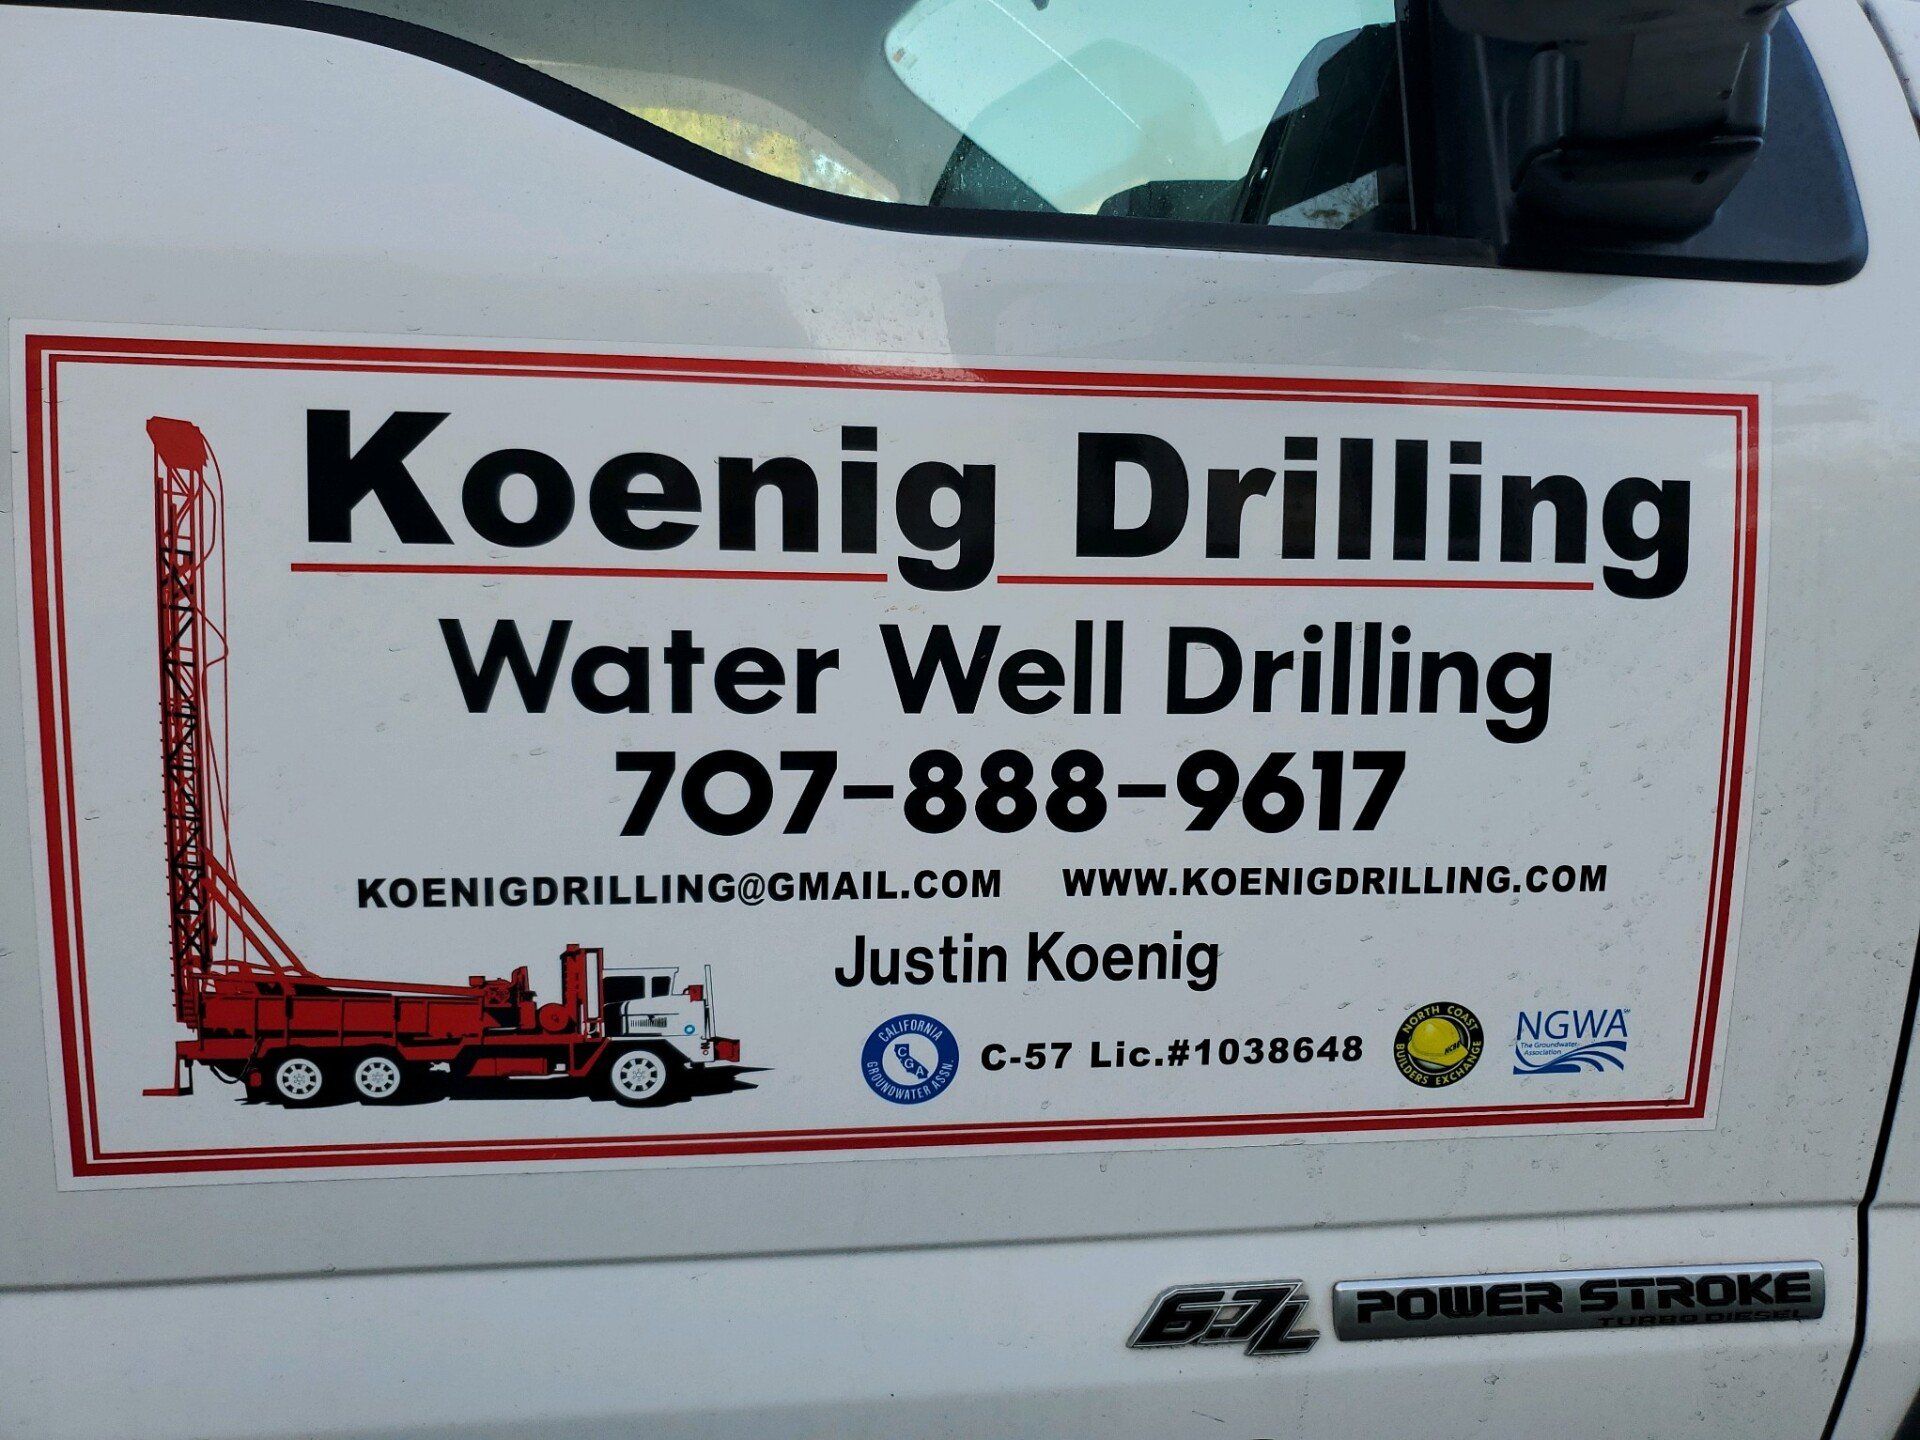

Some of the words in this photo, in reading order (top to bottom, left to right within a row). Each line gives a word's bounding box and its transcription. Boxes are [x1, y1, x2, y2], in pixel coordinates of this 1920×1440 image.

[307, 409, 995, 591] Koenig
[1076, 432, 1690, 599] Drilling
[439, 619, 839, 714] Water
[879, 620, 1123, 714] Well
[1167, 622, 1551, 742] Drilling
[616, 749, 1405, 836] 707-888-9617
[358, 870, 1001, 909] KOENIGDRILLING@GMAIL.COM
[1063, 865, 1608, 896] WWW.KOENIGDRILLING.COM
[835, 933, 1006, 988] Justin
[1028, 931, 1219, 992] Koenig
[878, 1019, 943, 1042] CALIFORNIA
[1402, 1005, 1440, 1034] NORTH
[1446, 1005, 1479, 1031] COAST
[1517, 1008, 1628, 1041] NGWA
[981, 1043, 1073, 1072] C-57
[1396, 1043, 1429, 1085] BUILDERS
[1435, 1040, 1482, 1086] EXCHANGE
[867, 1061, 931, 1100] GROUNDWATER
[1357, 1281, 1563, 1323] POWER
[1579, 1271, 1811, 1313] STROKE
